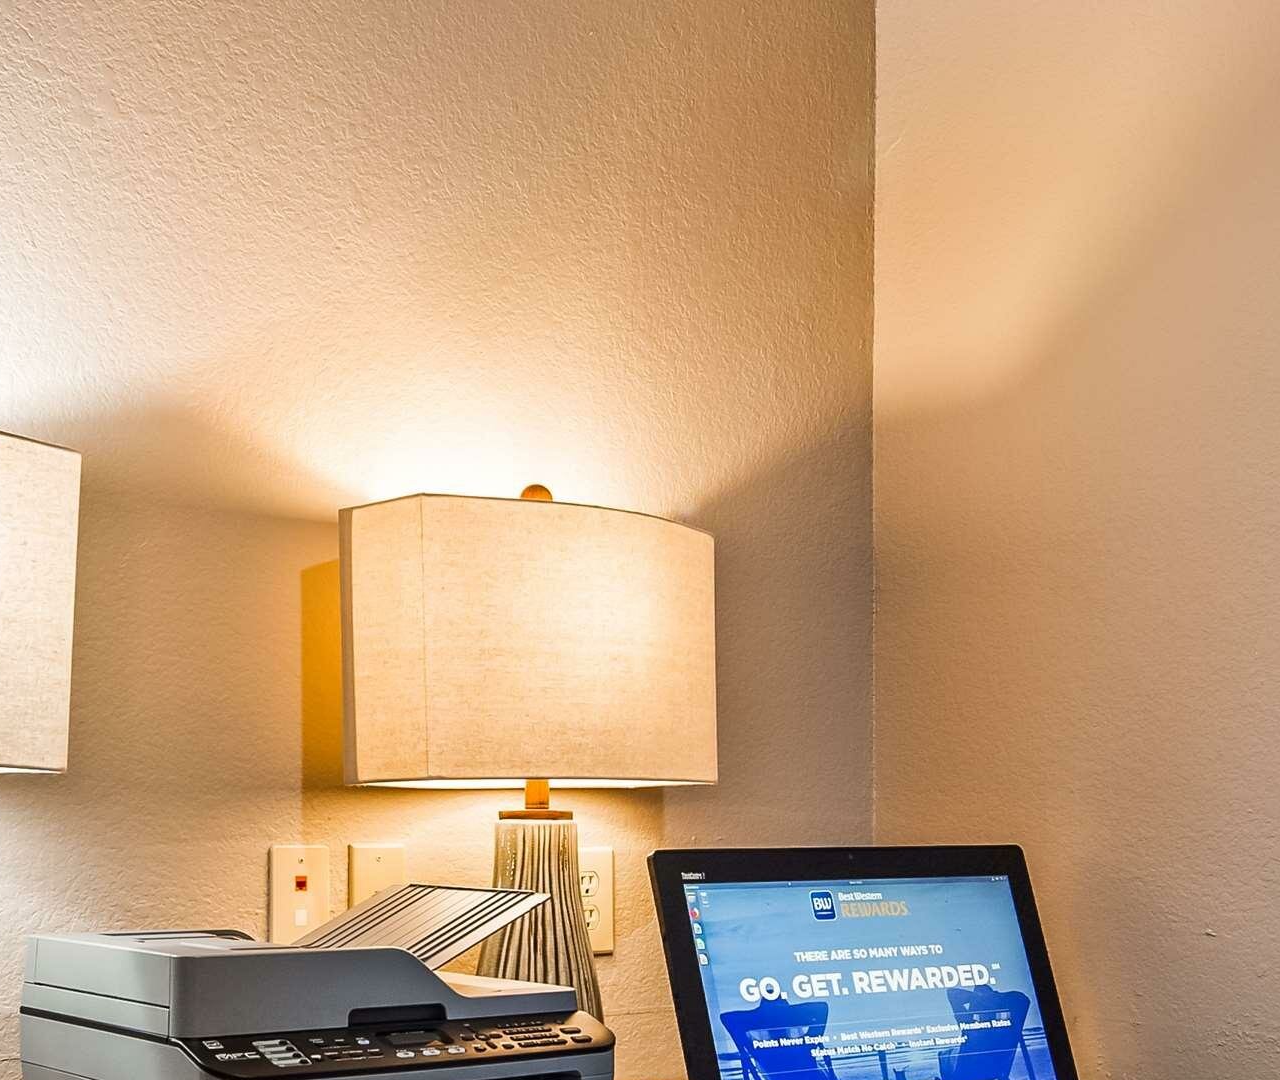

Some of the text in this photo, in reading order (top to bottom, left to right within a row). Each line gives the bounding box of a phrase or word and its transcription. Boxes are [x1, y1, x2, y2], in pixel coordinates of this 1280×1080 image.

[812, 897, 832, 911] BW
[837, 891, 883, 901] Best Western
[793, 944, 943, 963] THERE ARE SO MANY WAYS TO
[739, 976, 788, 1002] GO.
[792, 972, 849, 999] GET.
[851, 963, 997, 994] REWARDED.
[752, 1039, 780, 1049] Points
[779, 1037, 804, 1047] Never
[804, 1035, 830, 1045] Expire
[840, 1031, 858, 1041] Best
[858, 1029, 891, 1040] Western
[925, 1023, 959, 1034] Exclusive
[959, 1020, 992, 1030] Members
[991, 1018, 1012, 1028] Rates
[810, 1047, 837, 1057] Status
[836, 1044, 861, 1056] Match
[861, 1043, 873, 1052] No
[908, 1038, 935, 1049] Instant
